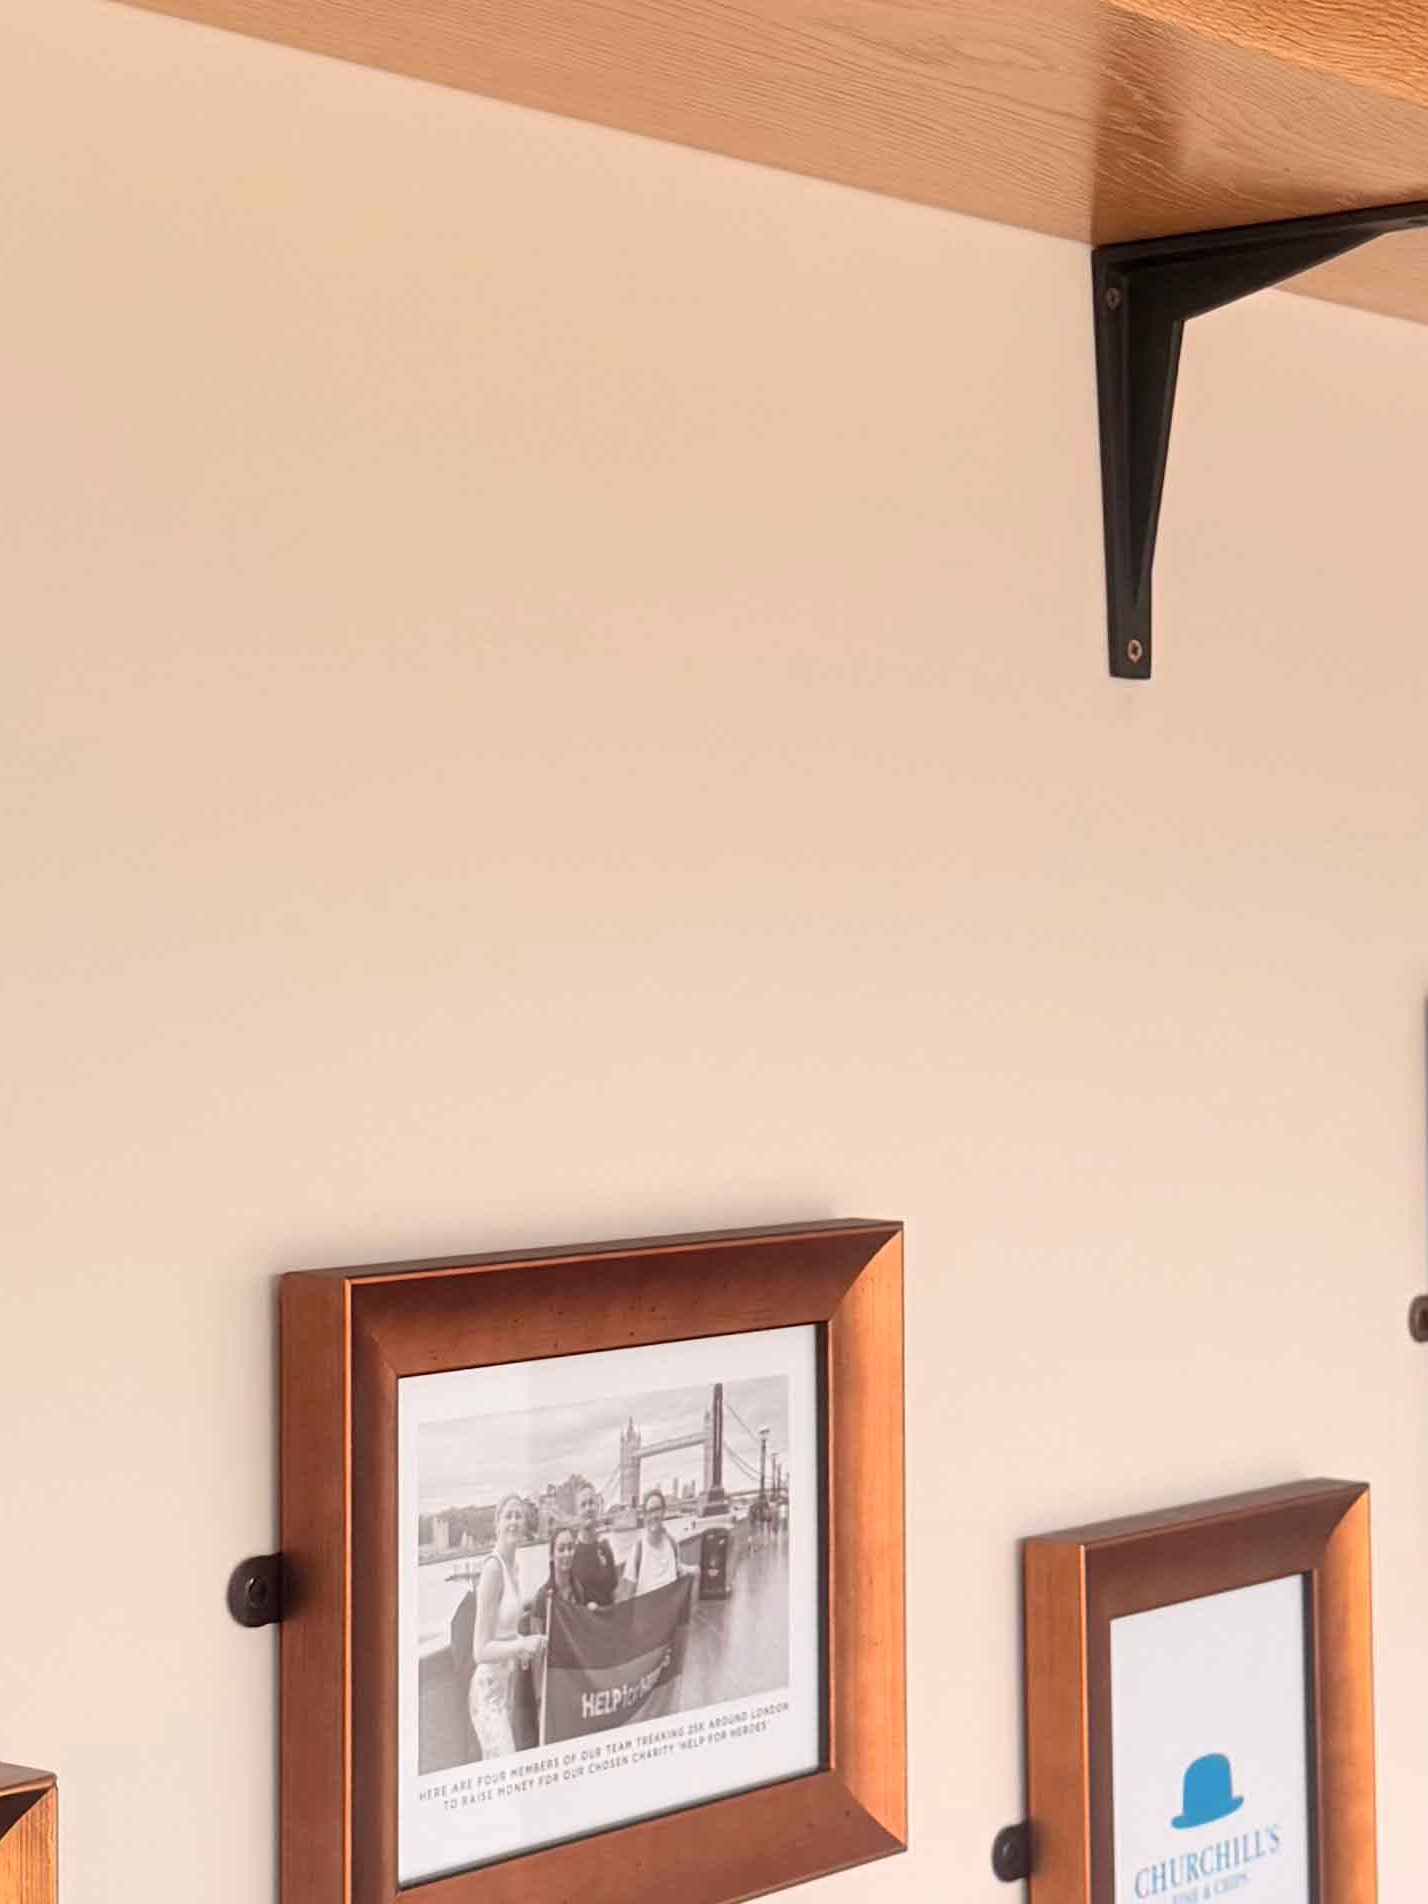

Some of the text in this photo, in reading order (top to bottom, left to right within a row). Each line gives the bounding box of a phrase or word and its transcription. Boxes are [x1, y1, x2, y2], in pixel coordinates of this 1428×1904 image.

[581, 1687, 622, 1719] HELP
[477, 1771, 507, 1787] FOUR
[606, 1739, 632, 1754] TEAM
[708, 1711, 748, 1729] AROUND
[750, 1702, 789, 1719] LONDON
[497, 1779, 534, 1796] MONEY
[538, 1772, 560, 1786] FOR
[563, 1766, 584, 1780] OUR
[588, 1754, 629, 1775] CHOSEN
[708, 1731, 726, 1744] FOR
